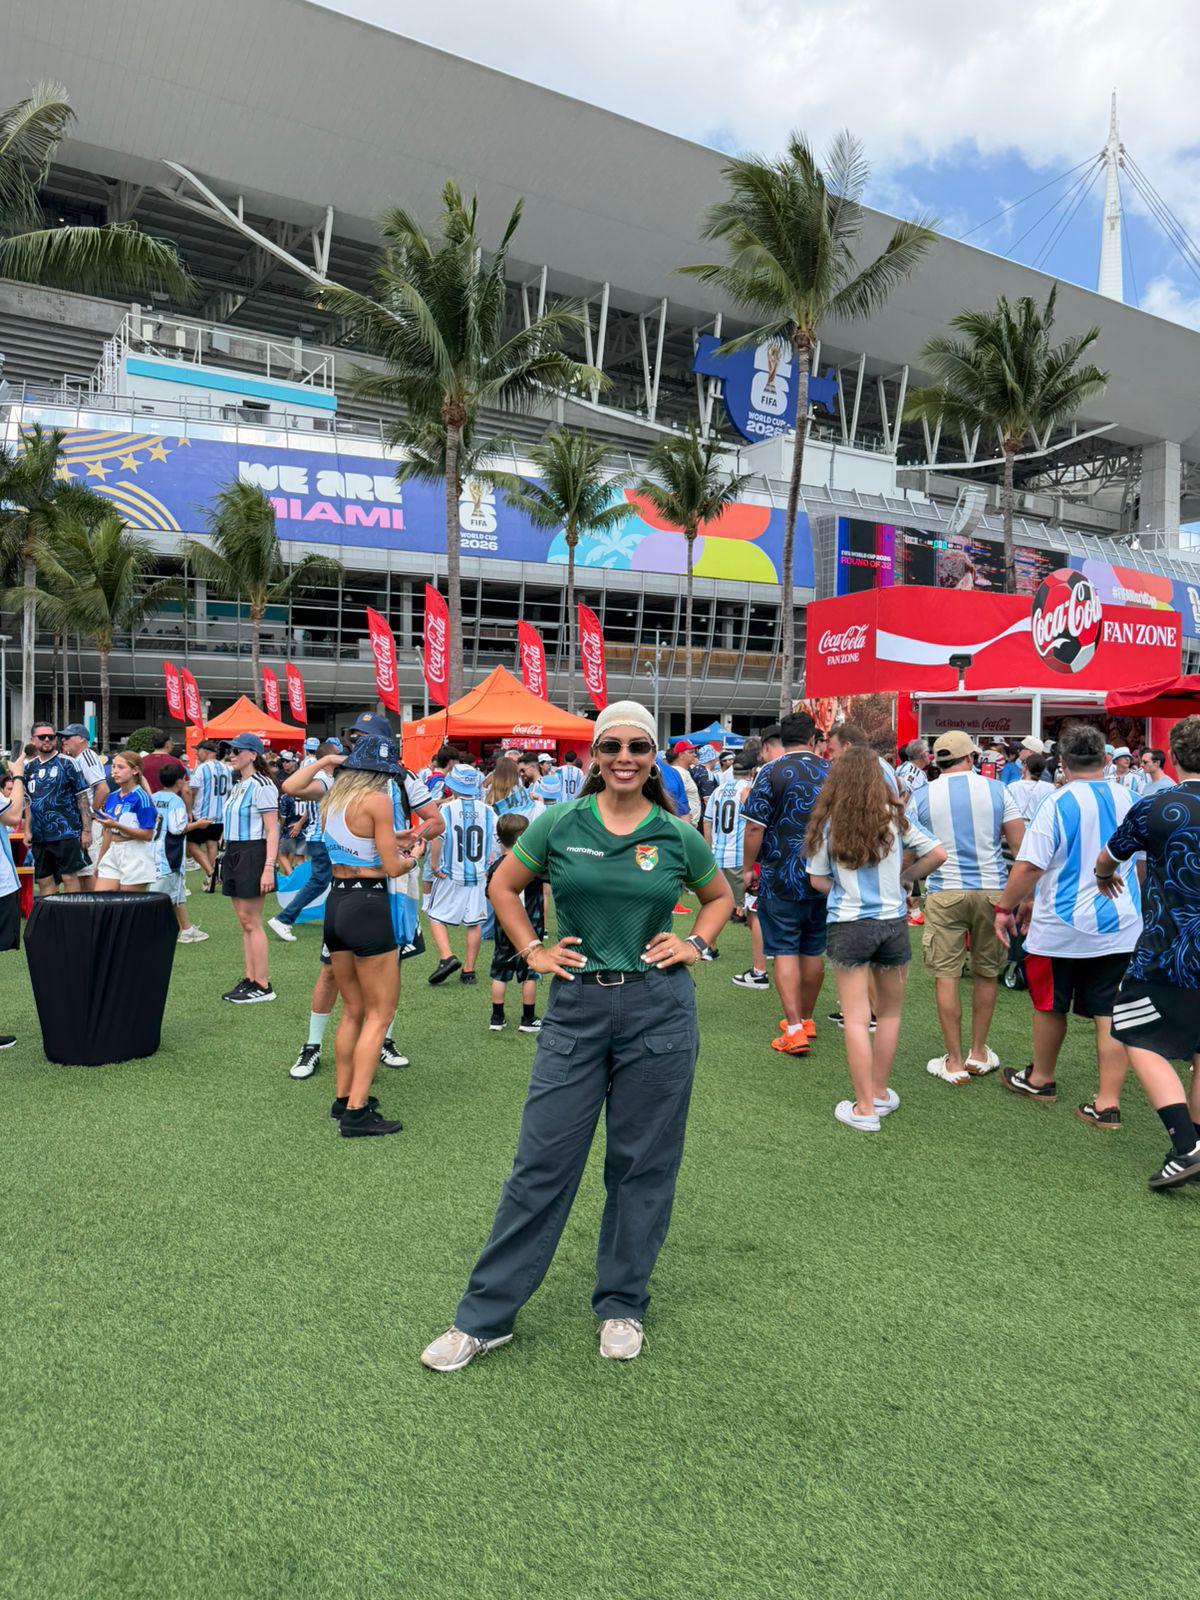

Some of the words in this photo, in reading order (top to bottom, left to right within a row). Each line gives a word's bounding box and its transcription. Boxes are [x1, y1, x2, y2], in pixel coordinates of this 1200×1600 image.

[761, 396, 777, 407] FIFA
[748, 411, 772, 423] WORLD
[772, 417, 786, 426] CUP
[238, 461, 309, 495] WE
[316, 470, 403, 504] ARE
[470, 519, 488, 527] FIFA
[460, 538, 499, 551] 2026
[841, 557, 868, 566] ROUND
[870, 560, 880, 568] OF
[881, 561, 892, 569] 32
[1103, 621, 1134, 644] FAN
[1135, 623, 1177, 647] ZONE
[827, 655, 840, 666] FAN
[840, 652, 860, 664] ZONE
[935, 718, 946, 727] Get
[213, 774, 228, 796] 10
[564, 779, 577, 795] 10
[294, 800, 307, 816] 10
[714, 799, 737, 834] 10
[454, 824, 484, 863] 10
[566, 846, 605, 857] marathon
